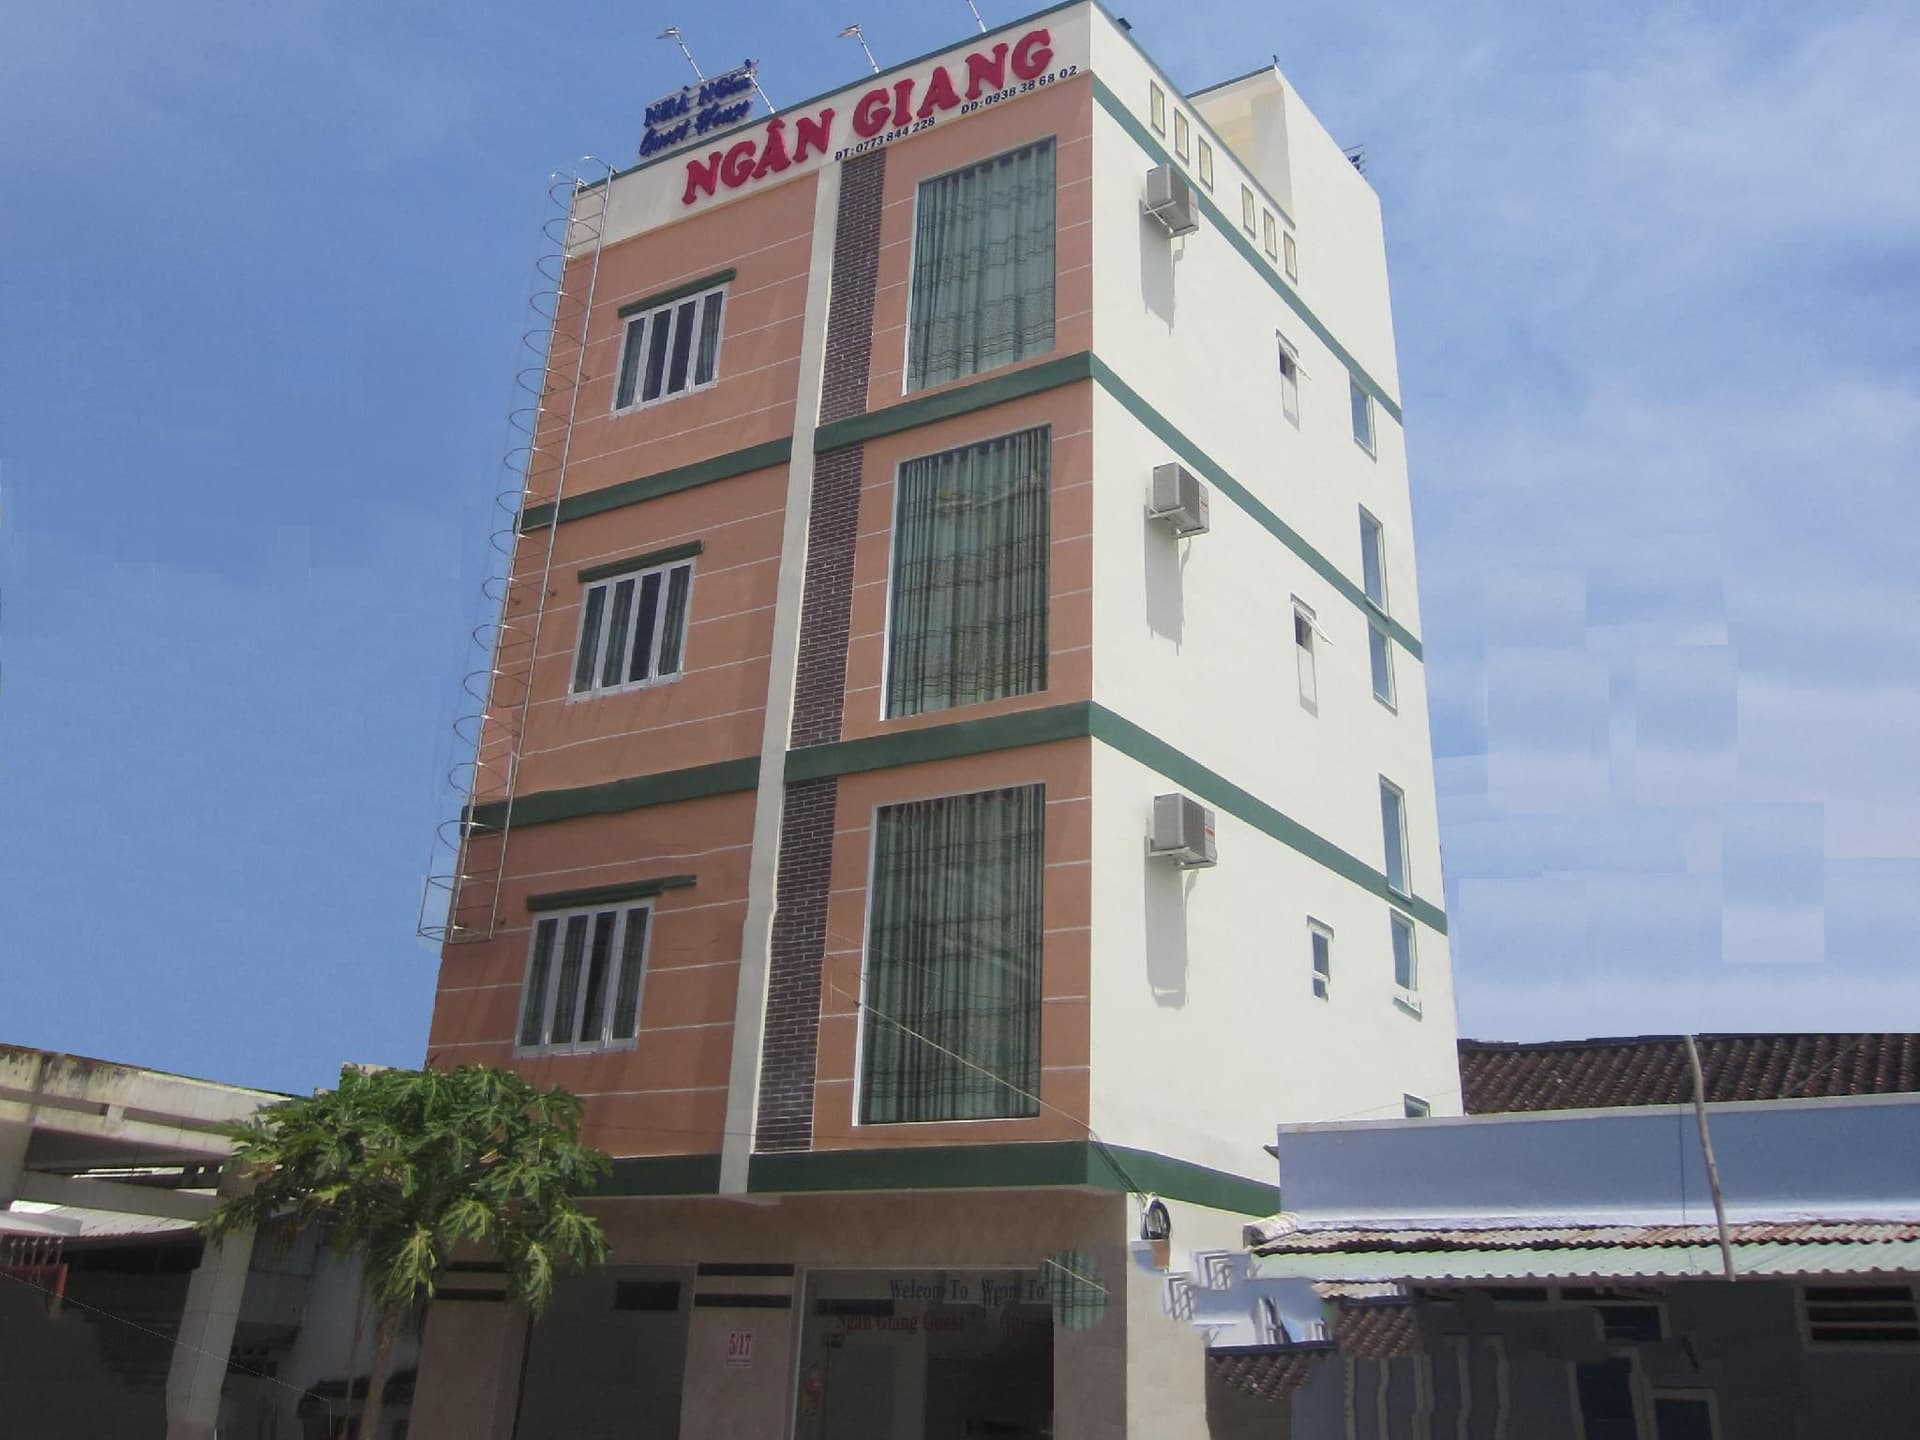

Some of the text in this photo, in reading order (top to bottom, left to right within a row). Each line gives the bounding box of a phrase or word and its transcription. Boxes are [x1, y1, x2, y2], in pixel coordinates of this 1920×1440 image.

[1020, 79, 1036, 93] 38
[1039, 73, 1055, 86] 68
[1059, 65, 1077, 79] 02
[681, 29, 1054, 204] NGÂN GIANG
[886, 126, 909, 142] 844
[912, 116, 936, 133] 228
[950, 1279, 968, 1299] To
